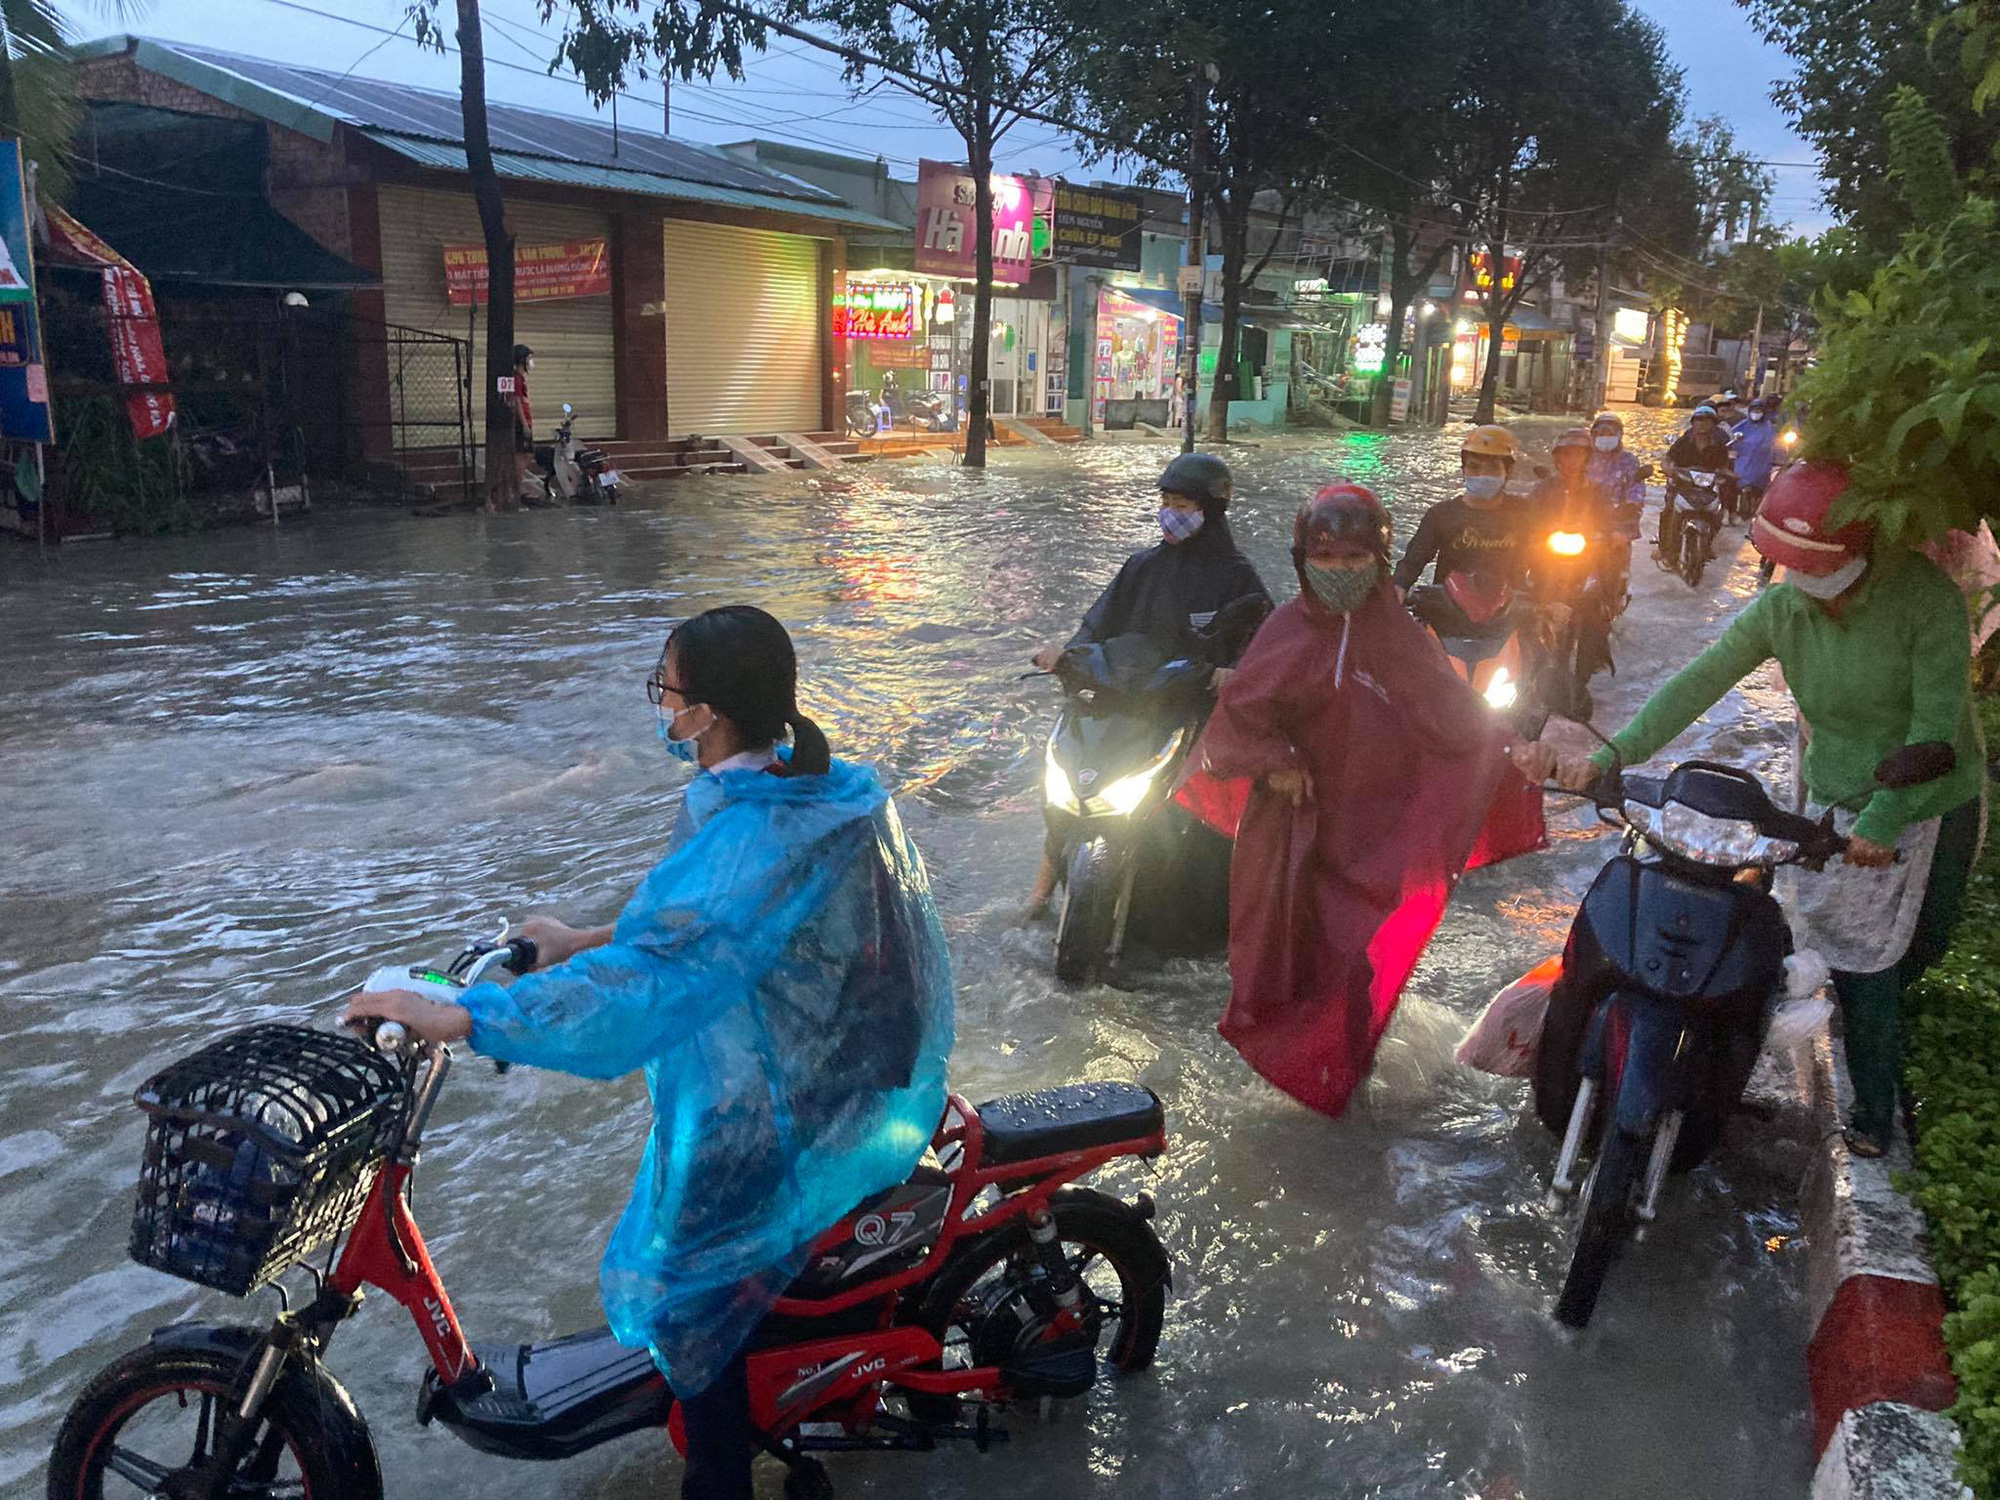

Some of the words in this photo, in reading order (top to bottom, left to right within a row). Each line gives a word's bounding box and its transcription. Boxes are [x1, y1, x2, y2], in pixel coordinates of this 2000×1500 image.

[923, 206, 965, 253] Hà
[854, 1210, 917, 1247] Q7
[423, 1296, 452, 1338] JVC
[851, 1357, 886, 1379] JVC
